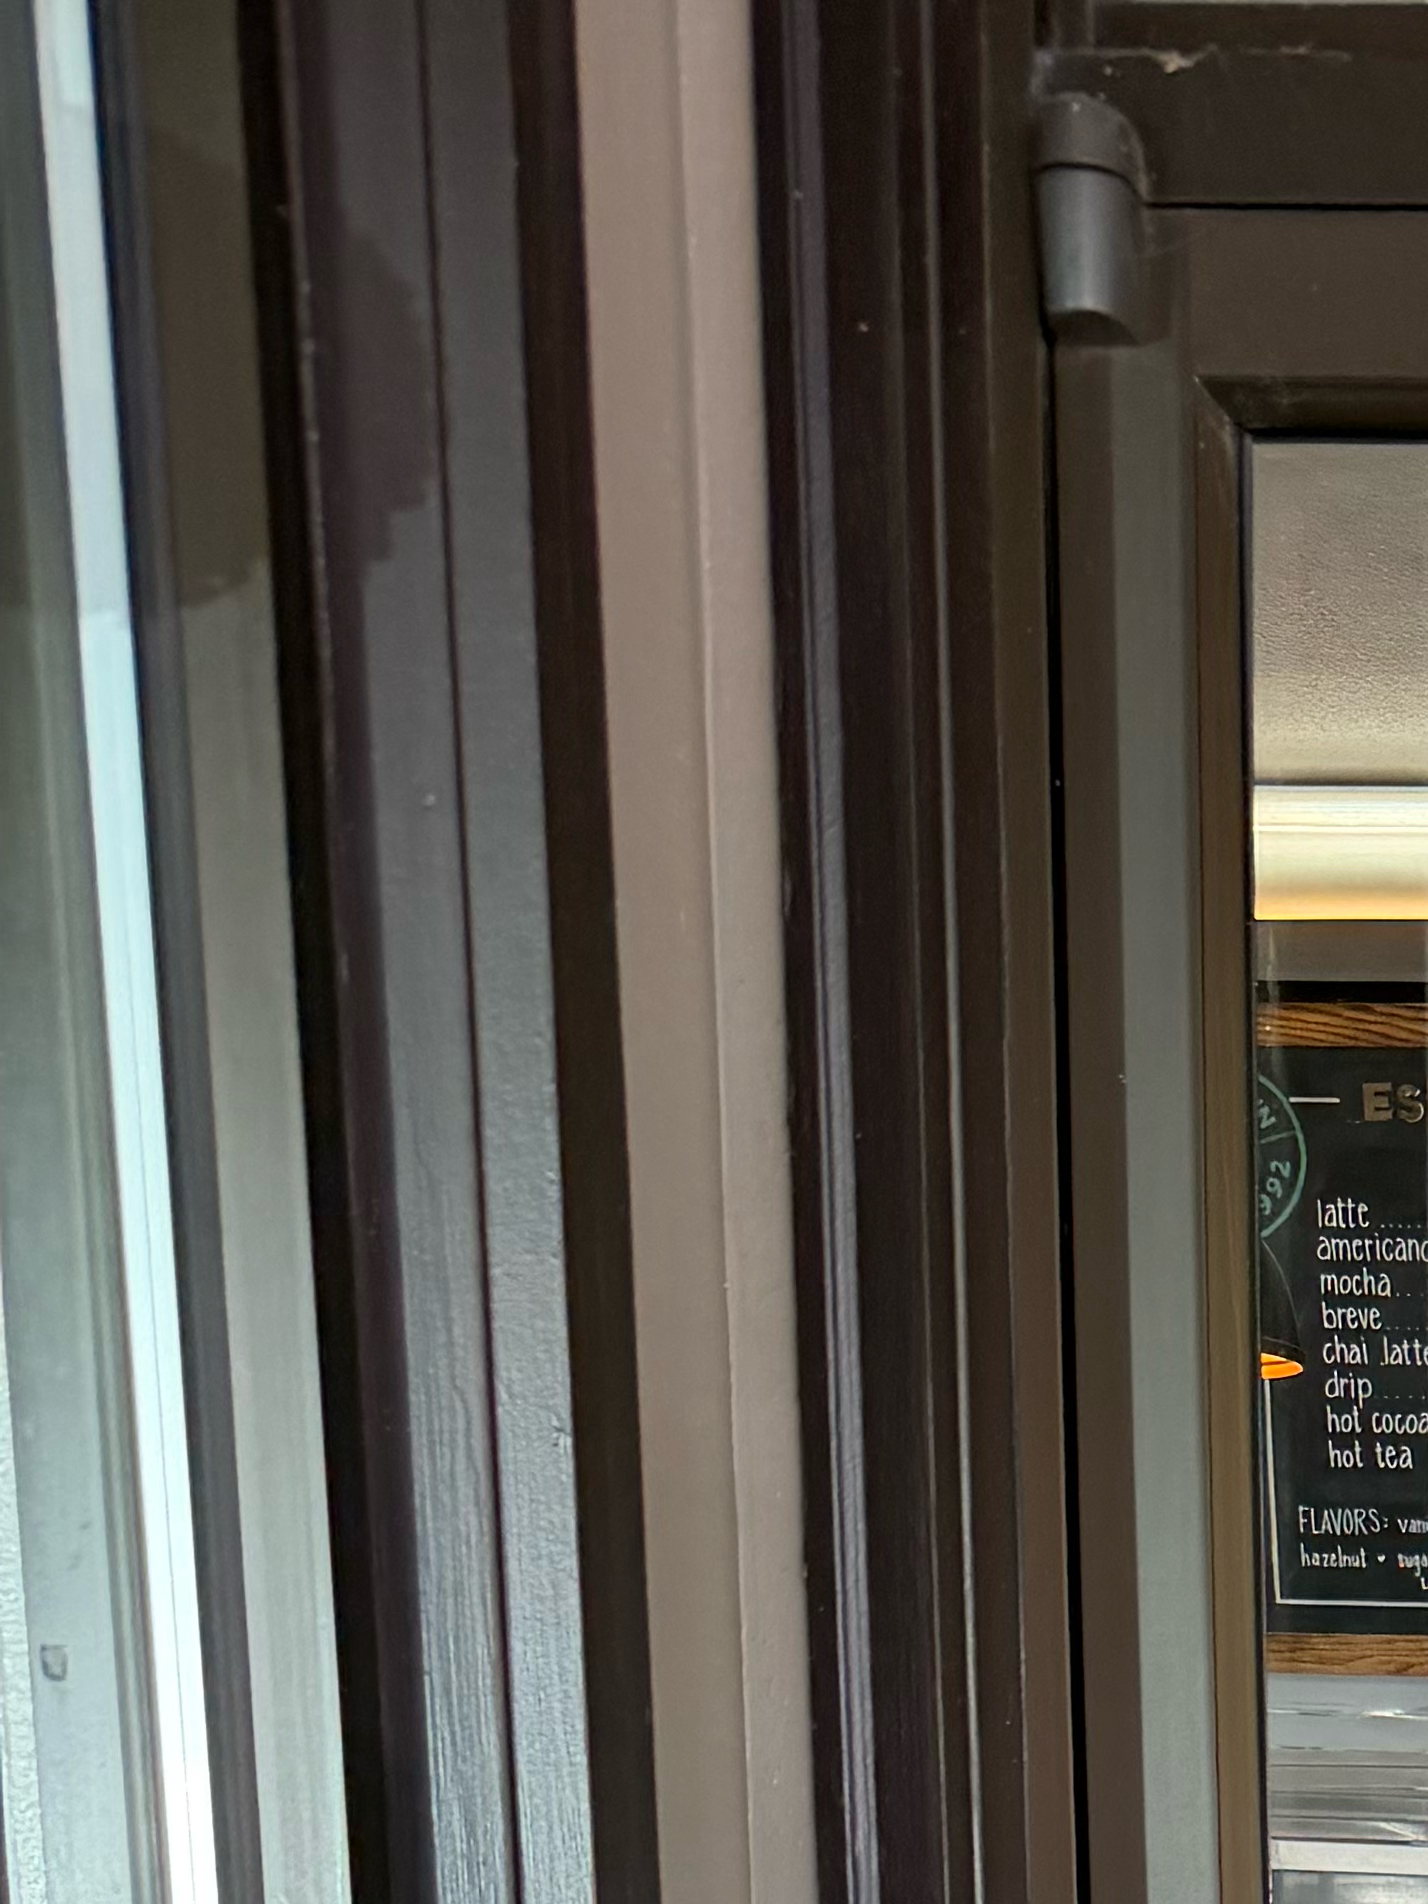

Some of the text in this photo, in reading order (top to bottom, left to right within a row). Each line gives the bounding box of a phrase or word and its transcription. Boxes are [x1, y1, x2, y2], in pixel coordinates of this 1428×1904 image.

[1316, 1197, 1370, 1229] latte
[1319, 1267, 1392, 1298] mocha
[1321, 1300, 1382, 1330] breve
[1322, 1334, 1369, 1365] chai
[1324, 1369, 1373, 1409] drip
[1326, 1404, 1363, 1434] hot
[1328, 1440, 1414, 1470] hot tea
[1298, 1505, 1389, 1536] FLAVORS:
[1300, 1543, 1367, 1568] hazelnut
